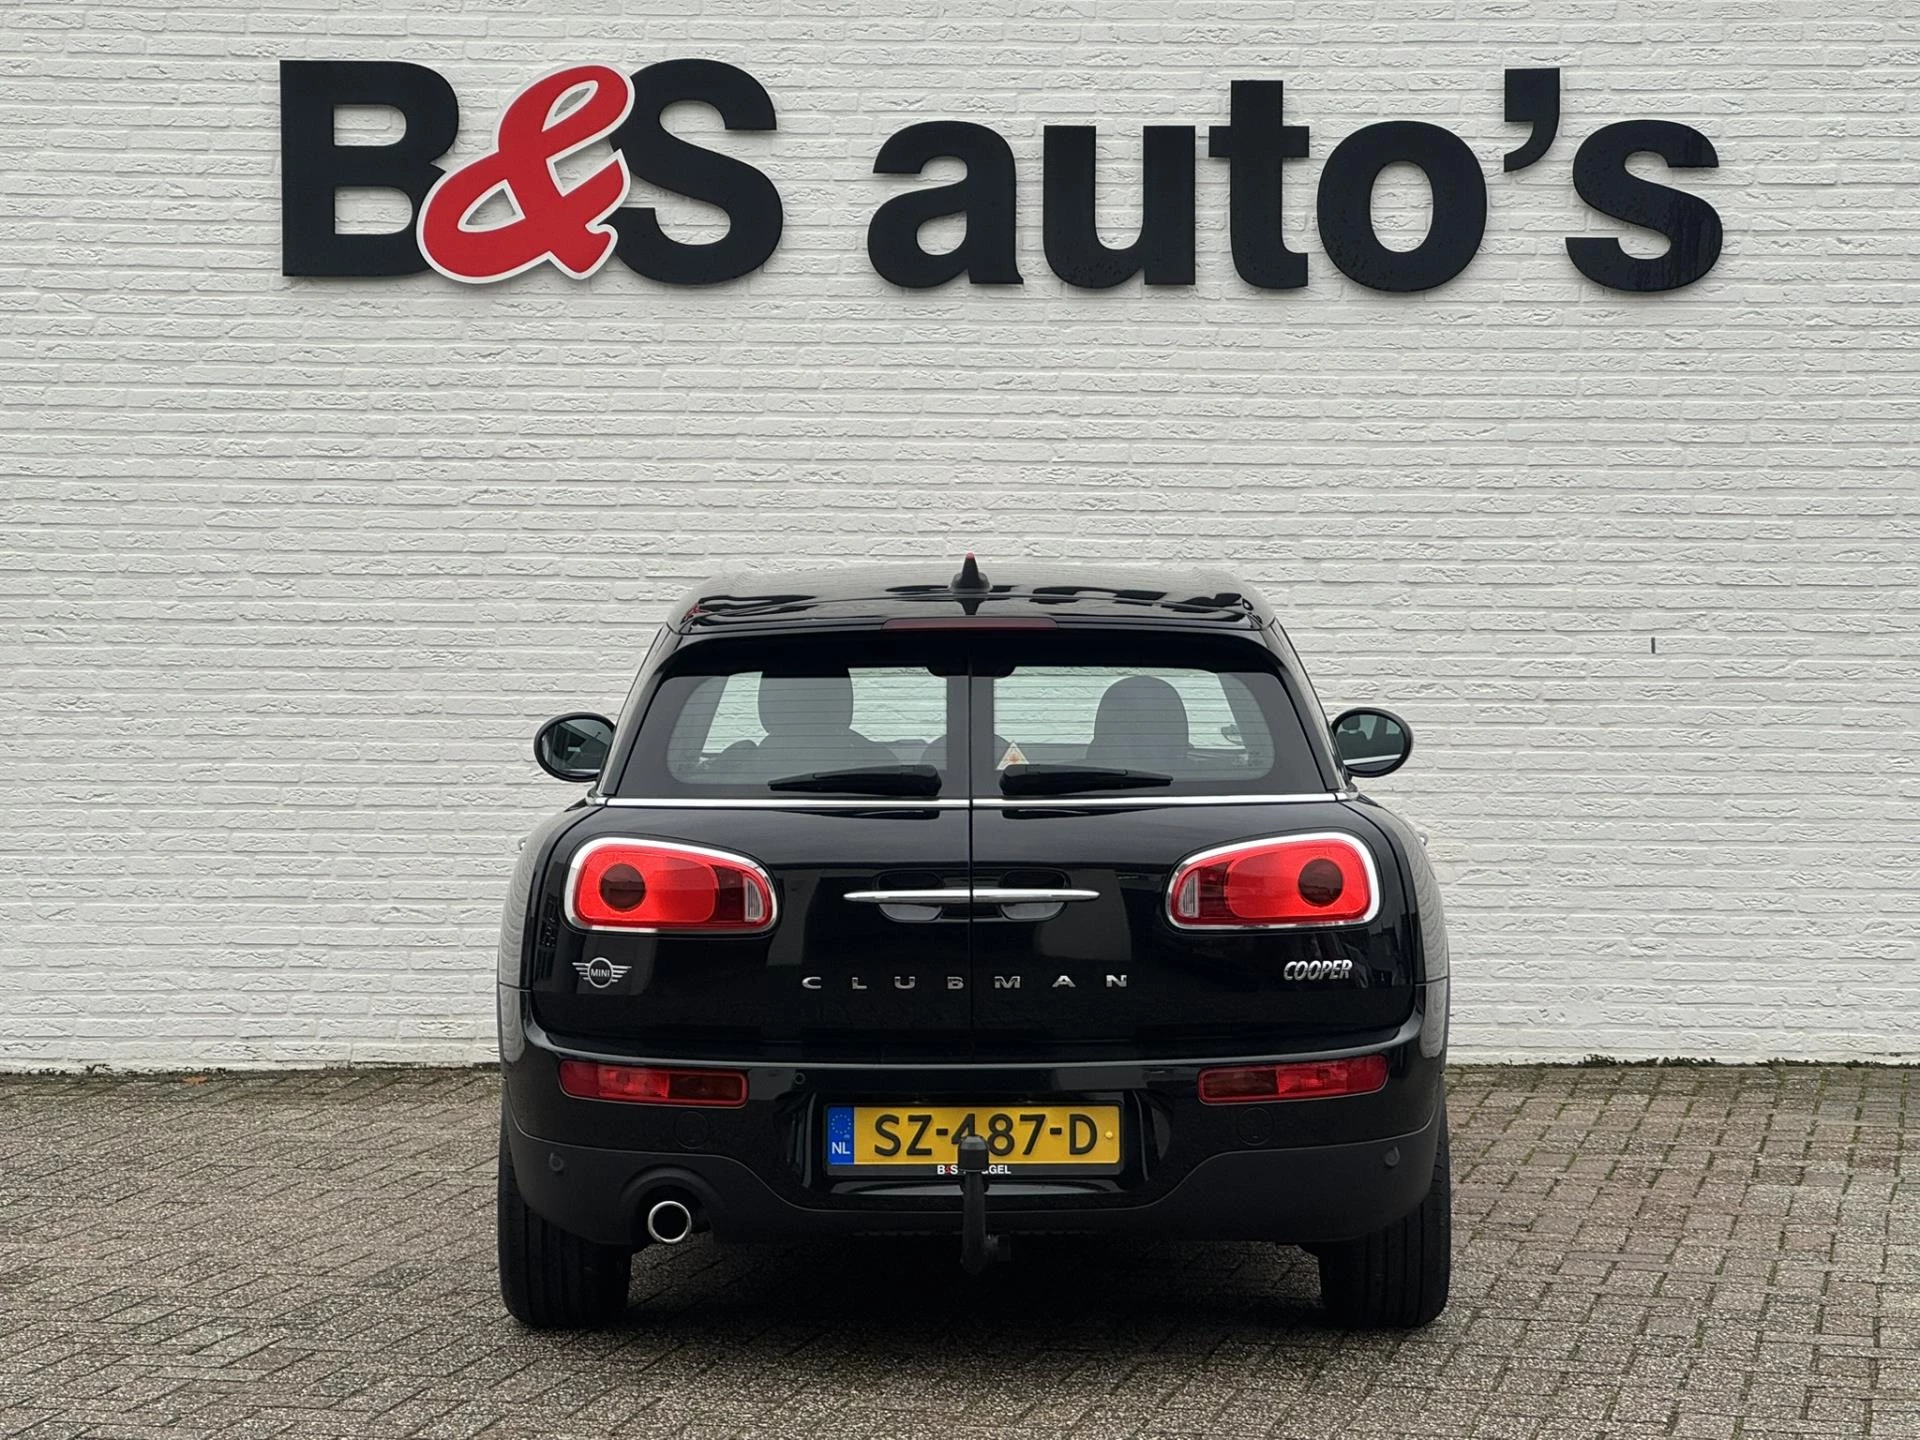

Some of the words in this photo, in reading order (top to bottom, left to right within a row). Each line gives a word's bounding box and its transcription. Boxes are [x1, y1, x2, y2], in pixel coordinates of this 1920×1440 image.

[280, 58, 783, 286] B&S
[867, 68, 1723, 292] auto's
[591, 968, 611, 977] MINI
[1283, 959, 1353, 980] COOPER
[801, 974, 1128, 990] CLUBMAN
[873, 1113, 1098, 1157] SZ-487-D
[831, 1141, 850, 1154] NL
